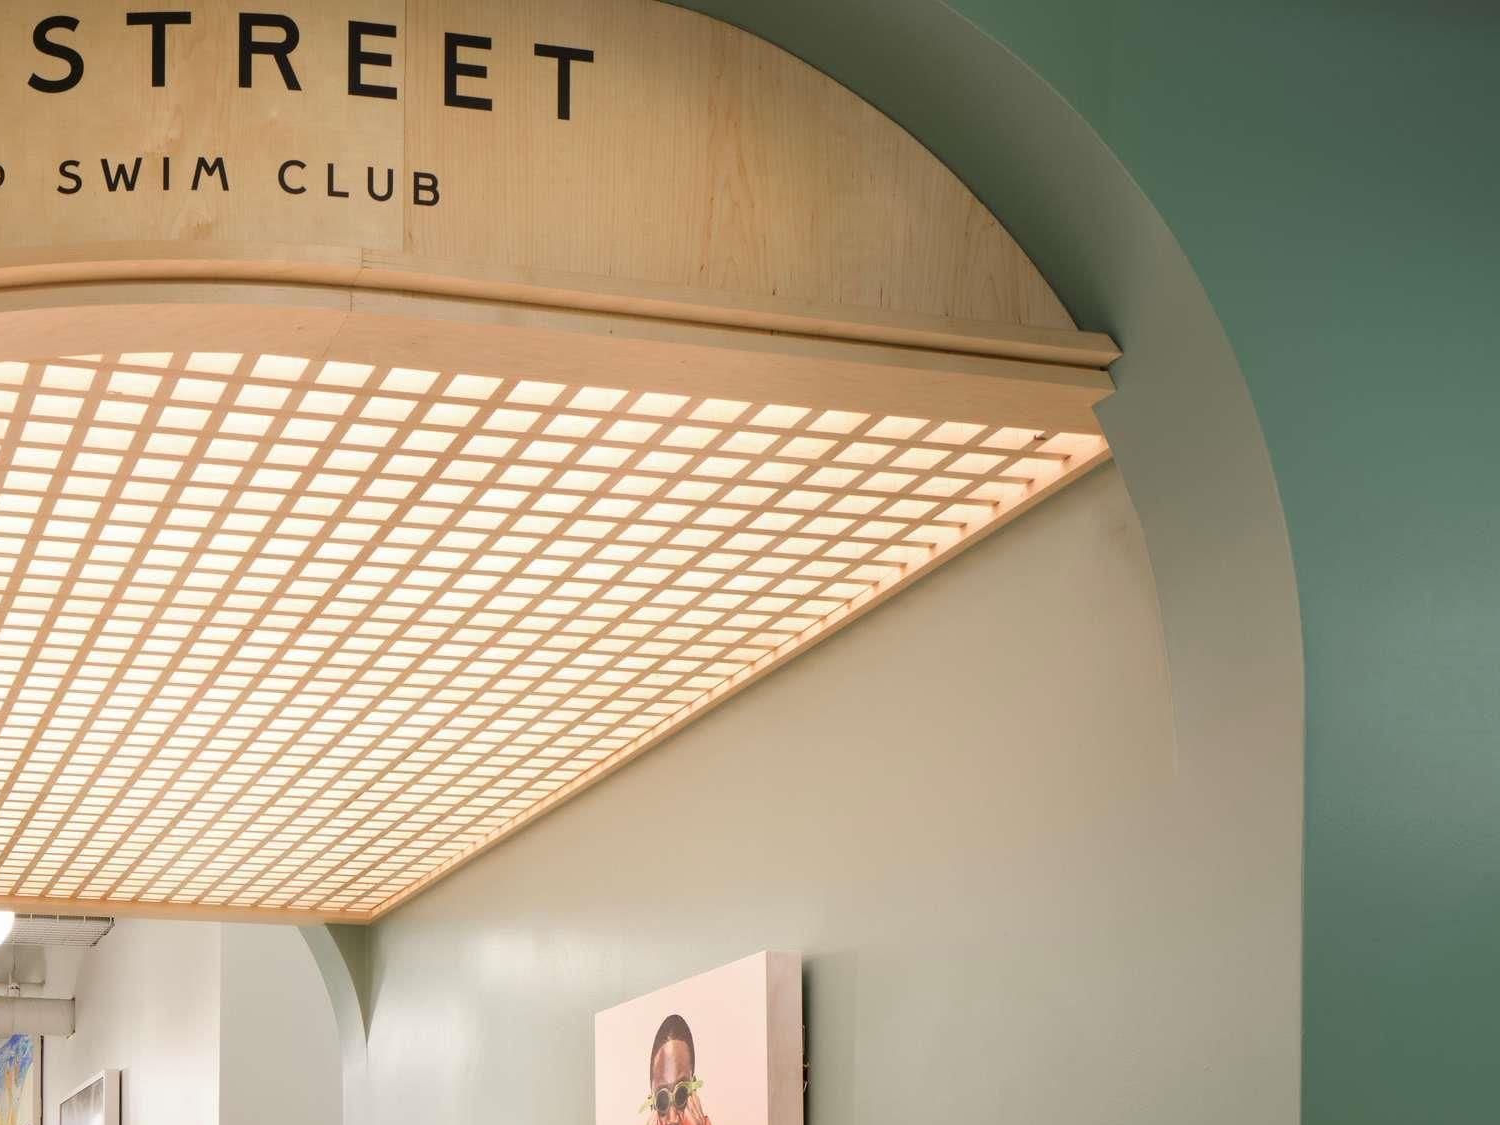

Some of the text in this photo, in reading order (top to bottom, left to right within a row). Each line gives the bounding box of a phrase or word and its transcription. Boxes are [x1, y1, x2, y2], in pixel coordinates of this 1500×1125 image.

[27, 10, 595, 121] STREET
[56, 156, 231, 196] SWIM
[277, 159, 441, 208] CLUB
